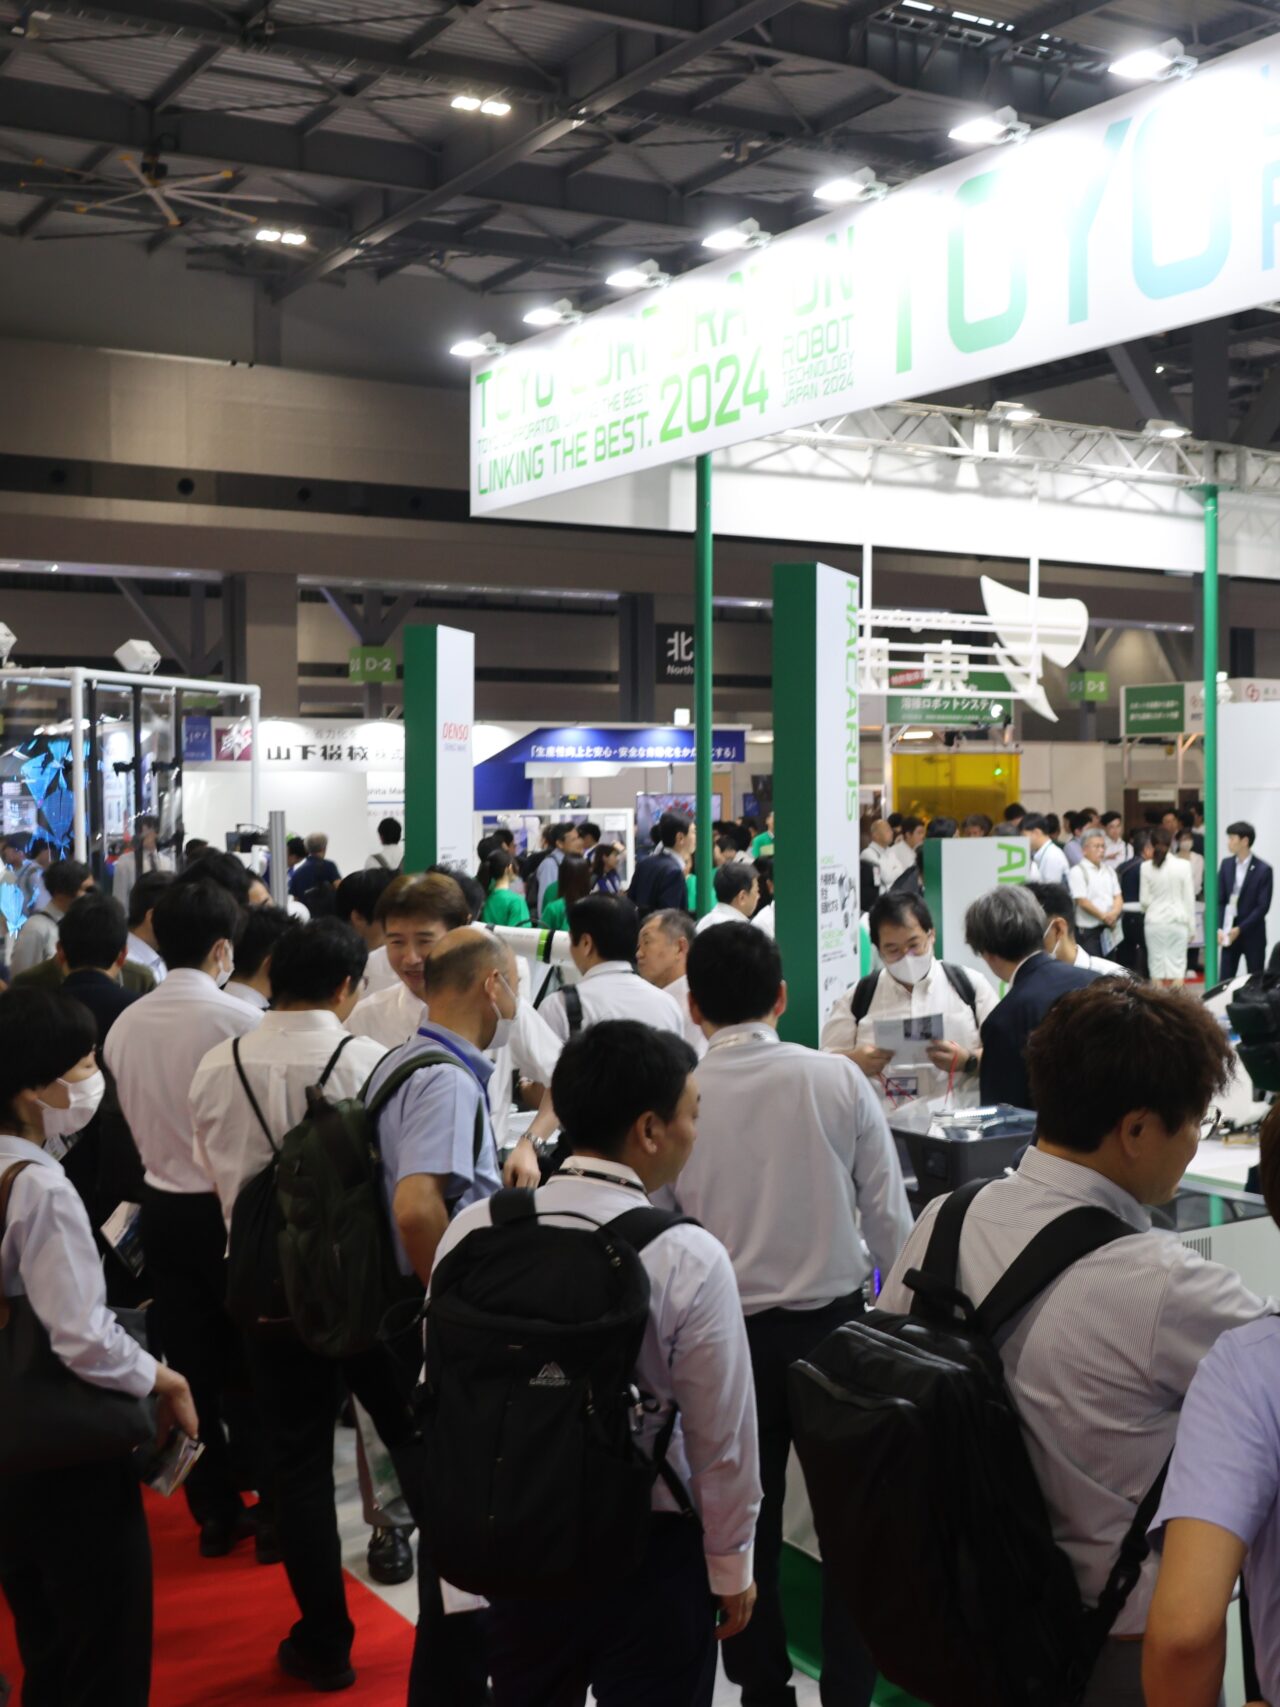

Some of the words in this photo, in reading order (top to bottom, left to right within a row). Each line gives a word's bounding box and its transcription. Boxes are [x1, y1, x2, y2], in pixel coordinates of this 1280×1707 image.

[782, 313, 855, 366] ROBOT
[781, 350, 855, 387] TECHNOLOGY
[781, 382, 818, 408] JAPAN
[823, 371, 856, 396] 2024
[476, 442, 545, 496] LINKING
[550, 430, 589, 475] THE
[594, 410, 653, 463] BEST.
[659, 346, 769, 444] 2024
[365, 656, 392, 672] D-2
[666, 631, 694, 662] 北
[666, 664, 694, 675] North
[846, 580, 858, 821] HACARUS
[442, 721, 469, 741] DENSO
